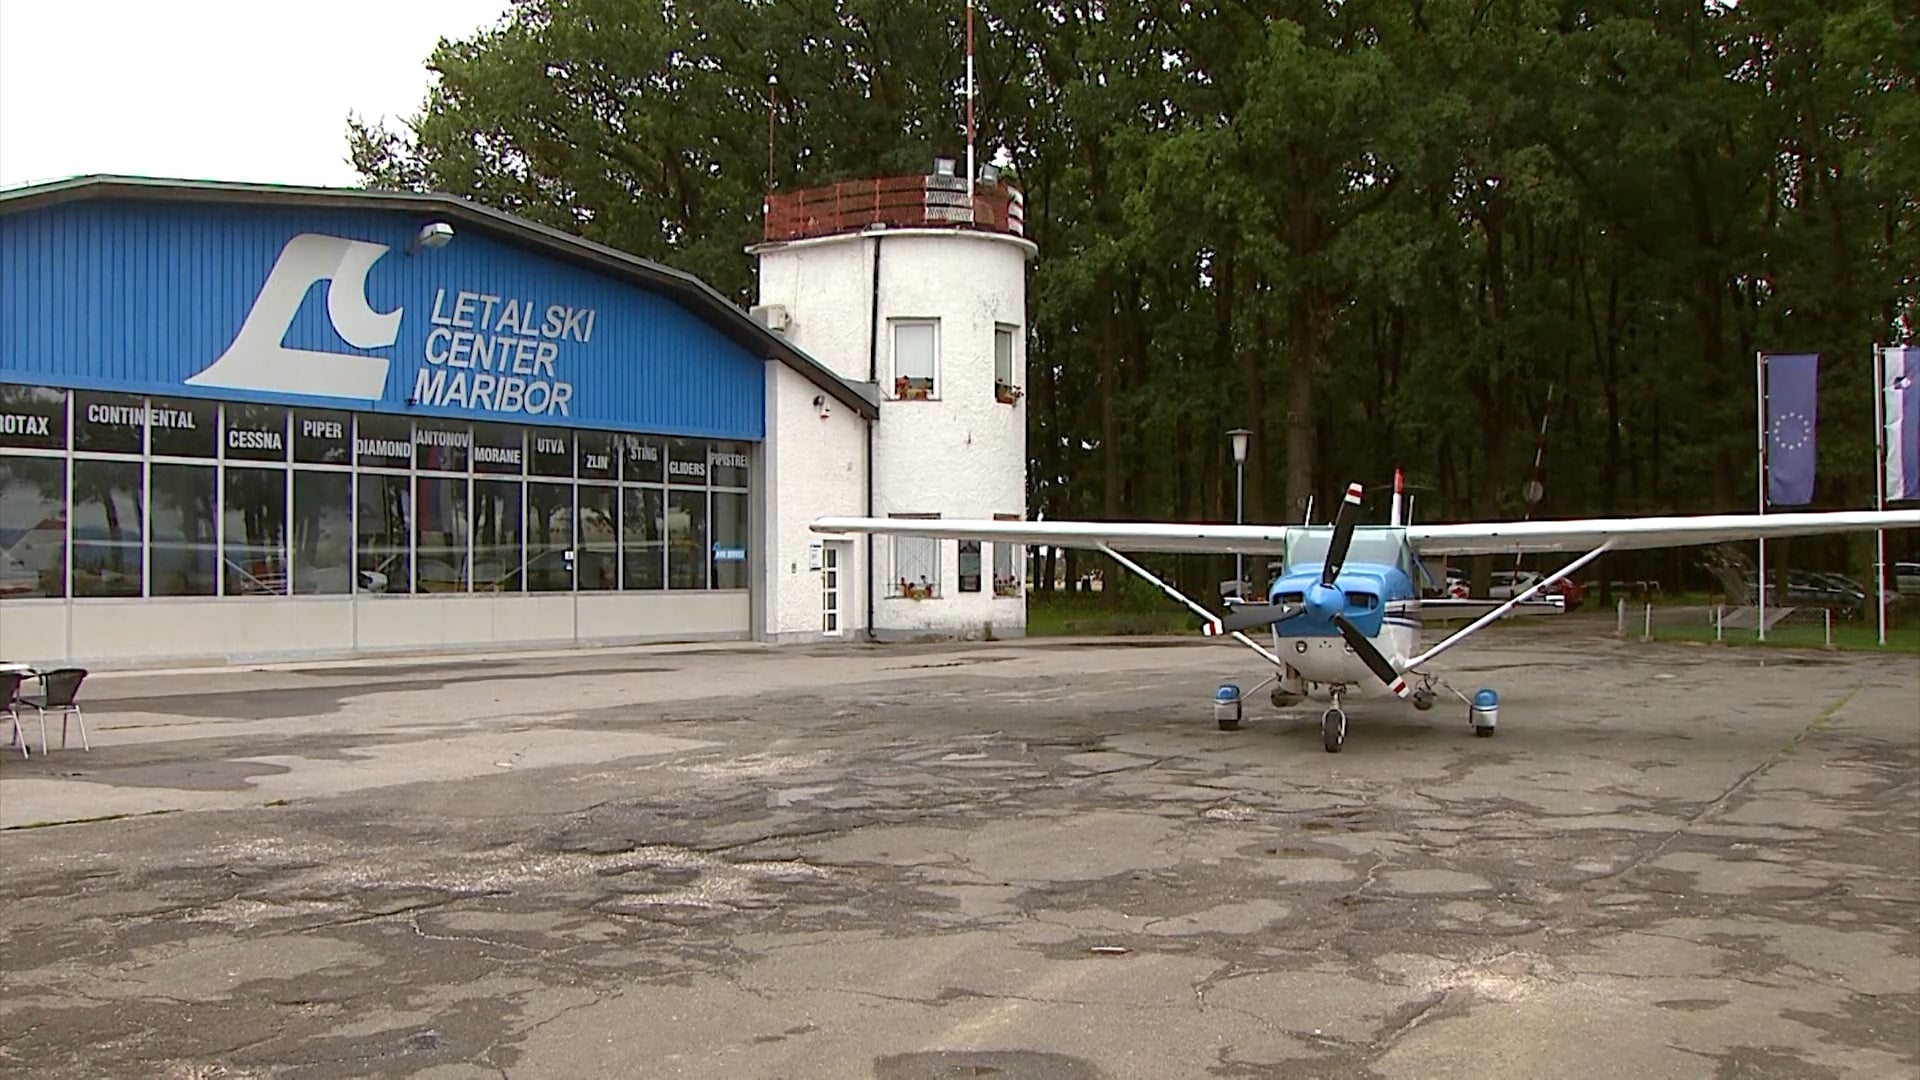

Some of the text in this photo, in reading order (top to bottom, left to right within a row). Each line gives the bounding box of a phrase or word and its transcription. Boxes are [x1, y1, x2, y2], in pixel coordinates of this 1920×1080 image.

[431, 288, 596, 342] LETALSKI
[425, 327, 558, 377] CENTER
[413, 368, 573, 417] MARIBOR
[88, 404, 196, 429] CONTINENTAL
[303, 420, 342, 438] PIPER
[229, 430, 282, 450] CESSNA
[416, 429, 469, 448] ANTONOV
[537, 438, 565, 454] UTVA
[357, 439, 411, 457] DIAMOND
[474, 447, 521, 464] MORANE
[631, 447, 658, 461] STING
[586, 455, 608, 469] ZLIN
[669, 461, 705, 476] GLIDERS
